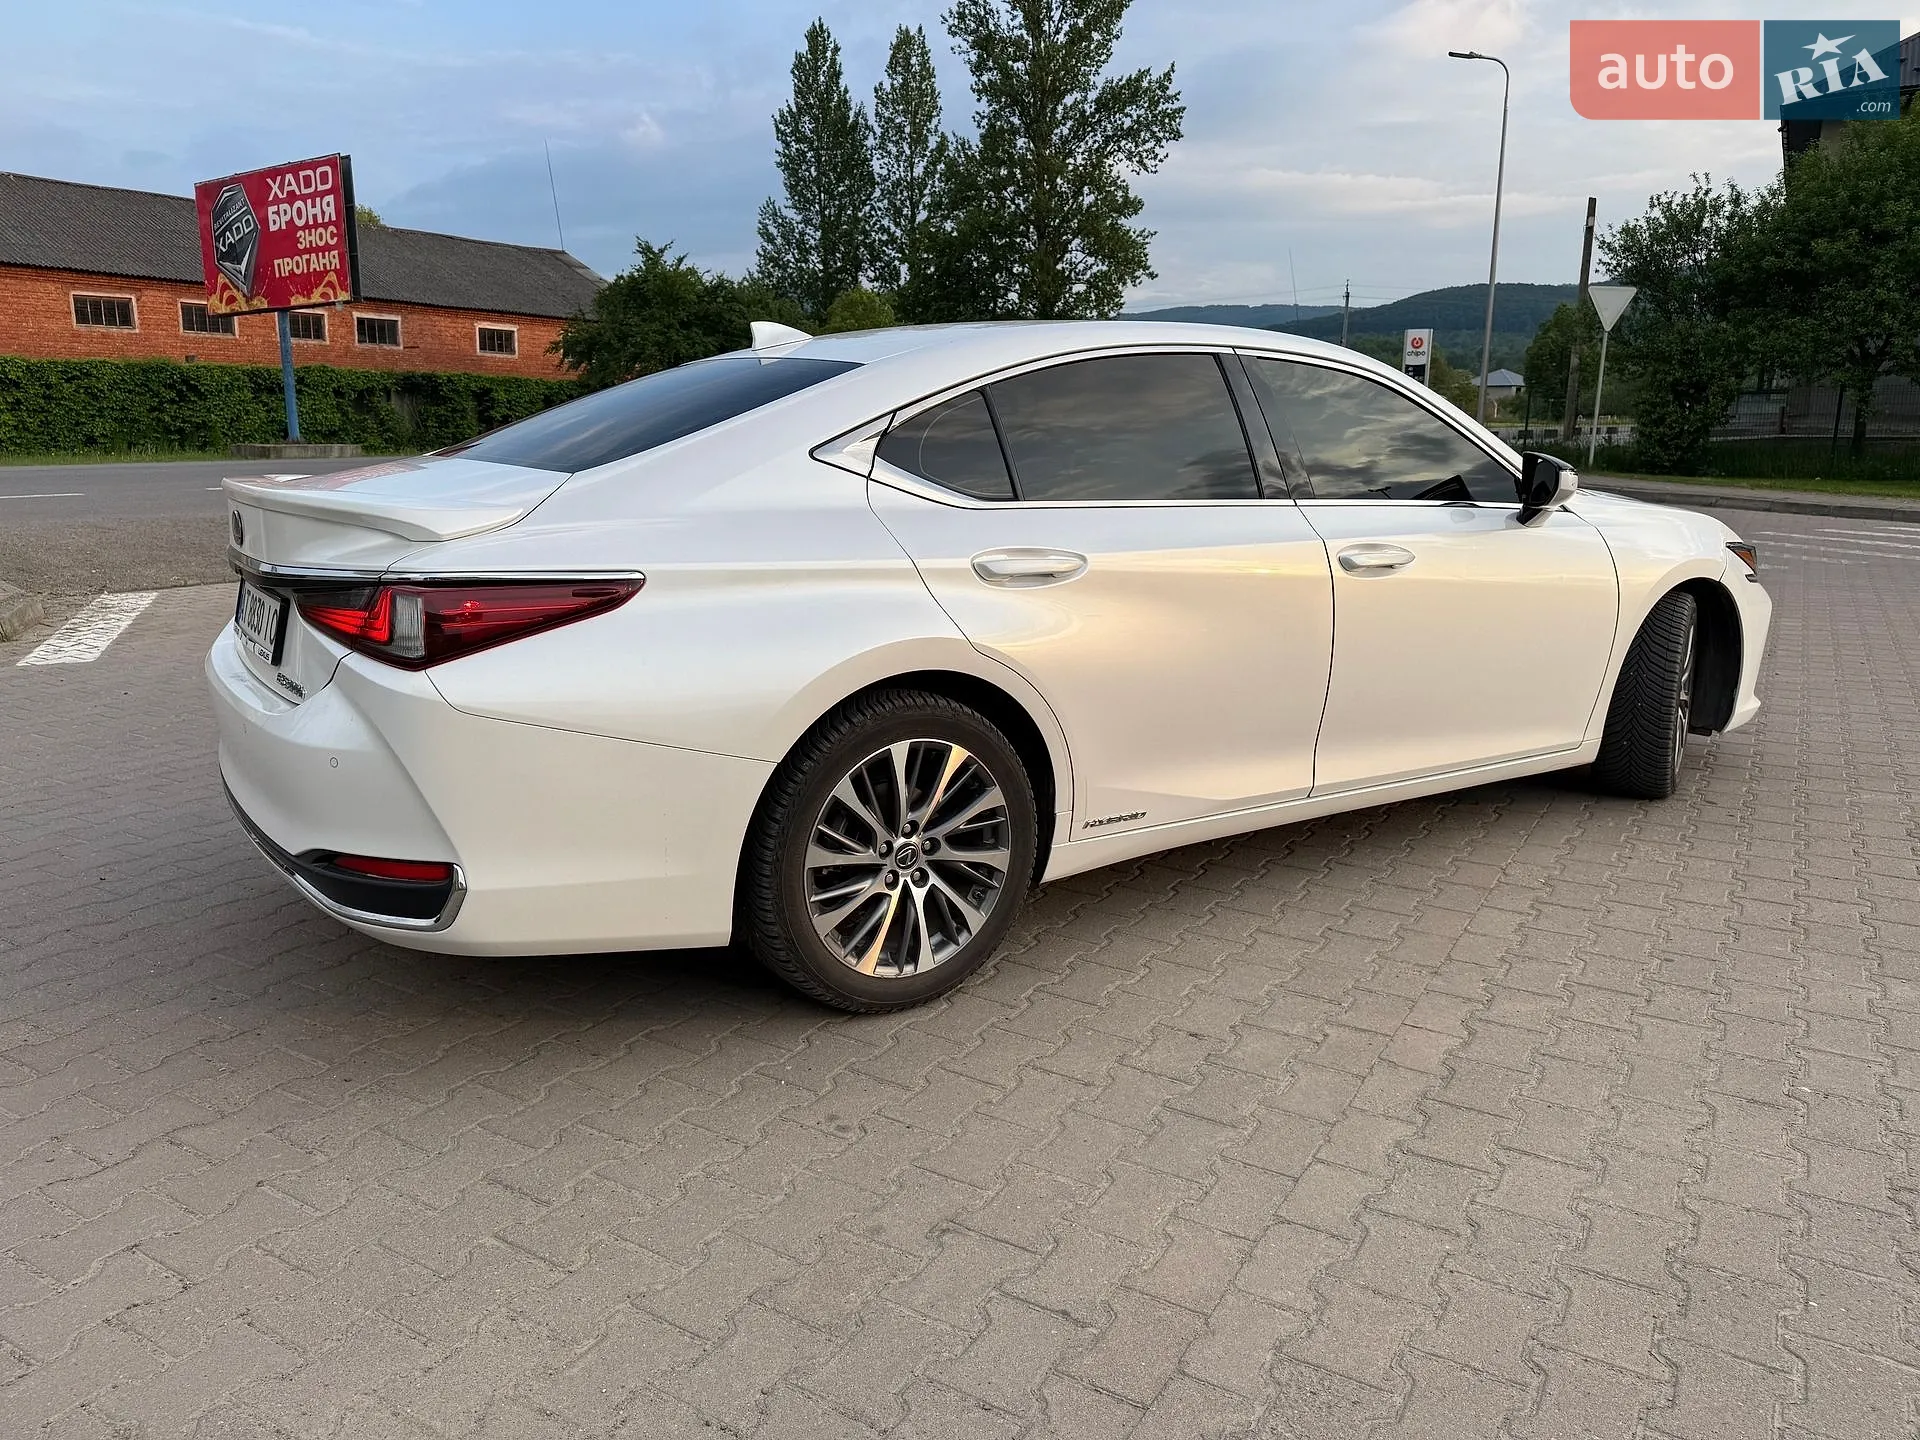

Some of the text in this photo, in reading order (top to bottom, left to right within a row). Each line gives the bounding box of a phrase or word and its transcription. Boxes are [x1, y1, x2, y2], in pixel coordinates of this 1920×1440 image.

[266, 165, 333, 201] XADO
[267, 194, 336, 232] БРОНЯ
[296, 225, 338, 250] ЗНОС
[274, 250, 341, 278] ПРОГАНЯ
